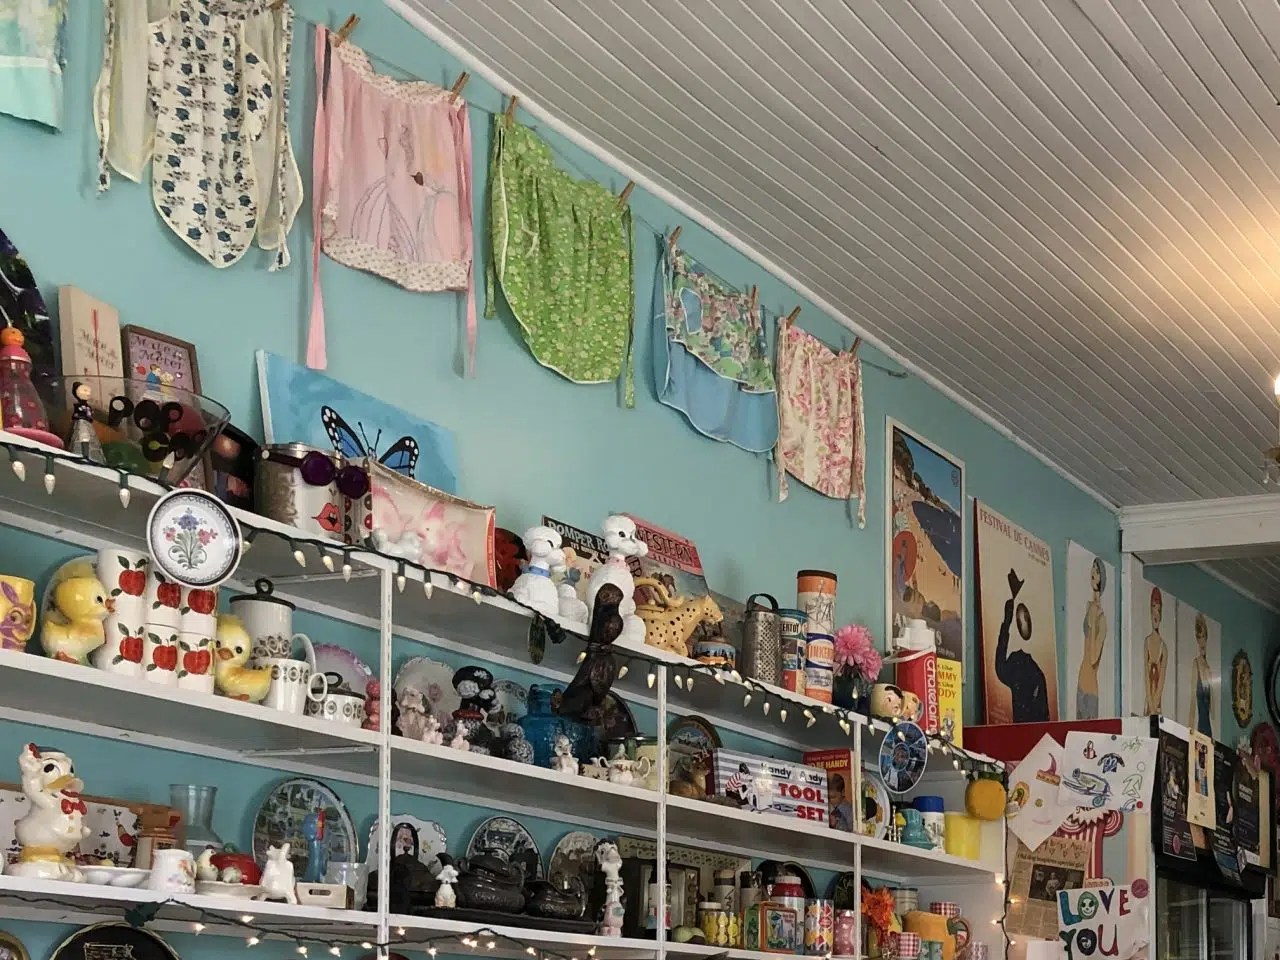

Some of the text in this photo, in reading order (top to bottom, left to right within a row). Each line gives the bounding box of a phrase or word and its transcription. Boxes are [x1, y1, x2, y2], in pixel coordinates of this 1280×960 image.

[980, 508, 1011, 539] FESTIVAL
[1014, 528, 1022, 545] DE
[1024, 536, 1050, 562] CANNES
[825, 758, 849, 769] HANDY
[778, 783, 825, 804] TOOL
[796, 804, 825, 822] SET
[1059, 888, 1131, 926] LOVE
